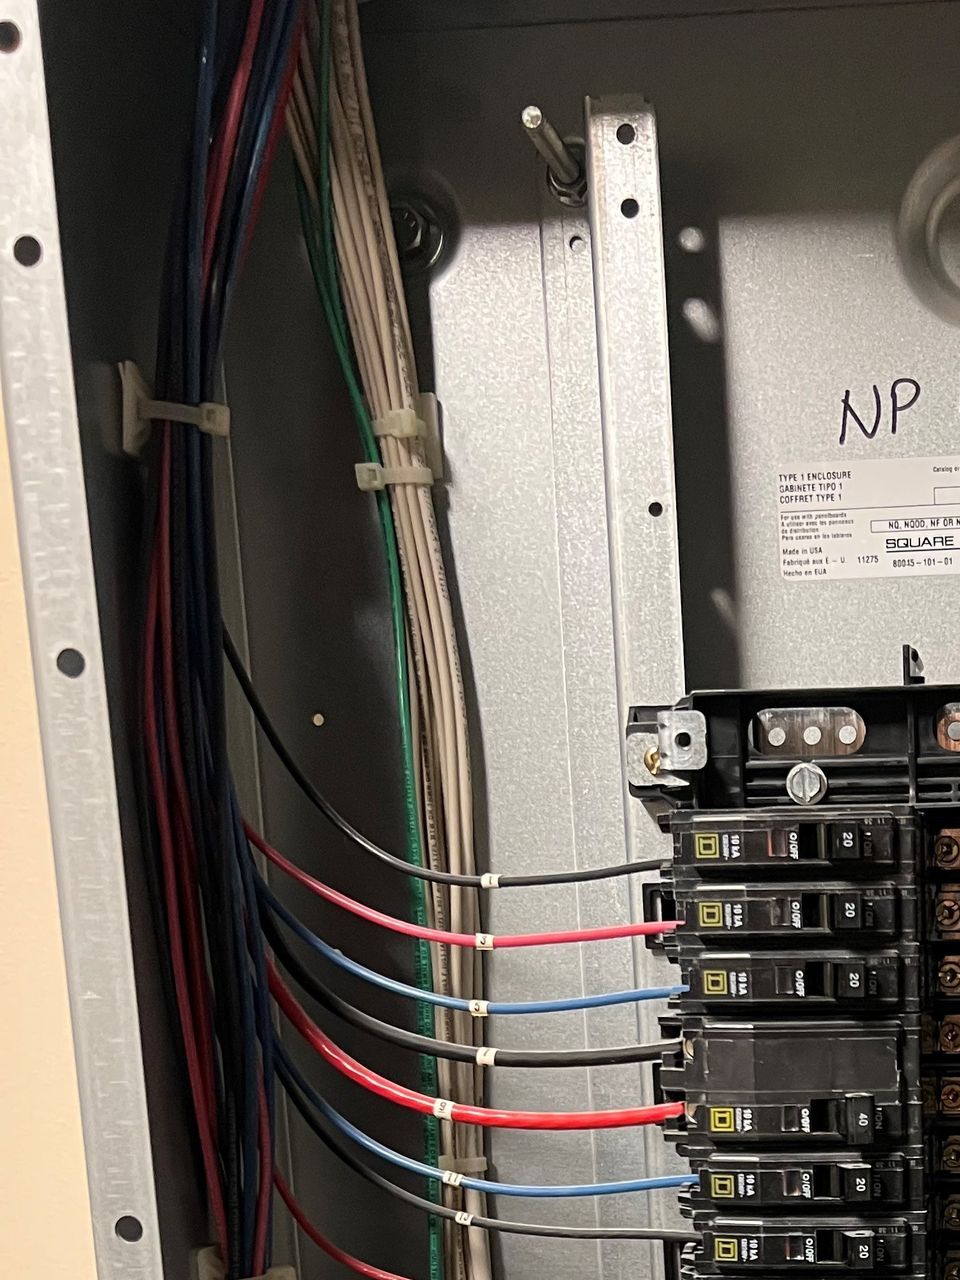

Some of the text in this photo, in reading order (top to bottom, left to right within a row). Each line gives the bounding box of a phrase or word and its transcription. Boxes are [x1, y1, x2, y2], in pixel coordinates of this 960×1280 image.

[840, 378, 920, 444] NP
[807, 471, 851, 480] ENCLOSURE
[780, 484, 815, 493] GABINETE
[780, 495, 813, 504] COFFRET
[816, 494, 834, 502] TYPE
[931, 519, 939, 527] NF
[943, 518, 954, 527] OR
[886, 536, 954, 550] SQUARE
[858, 555, 878, 563] 11275
[843, 833, 853, 847] 20
[846, 903, 855, 917] 20
[850, 973, 859, 987] 20
[859, 1113, 868, 1125] 40
[856, 1178, 865, 1191] 20
[860, 1245, 868, 1258] 20
